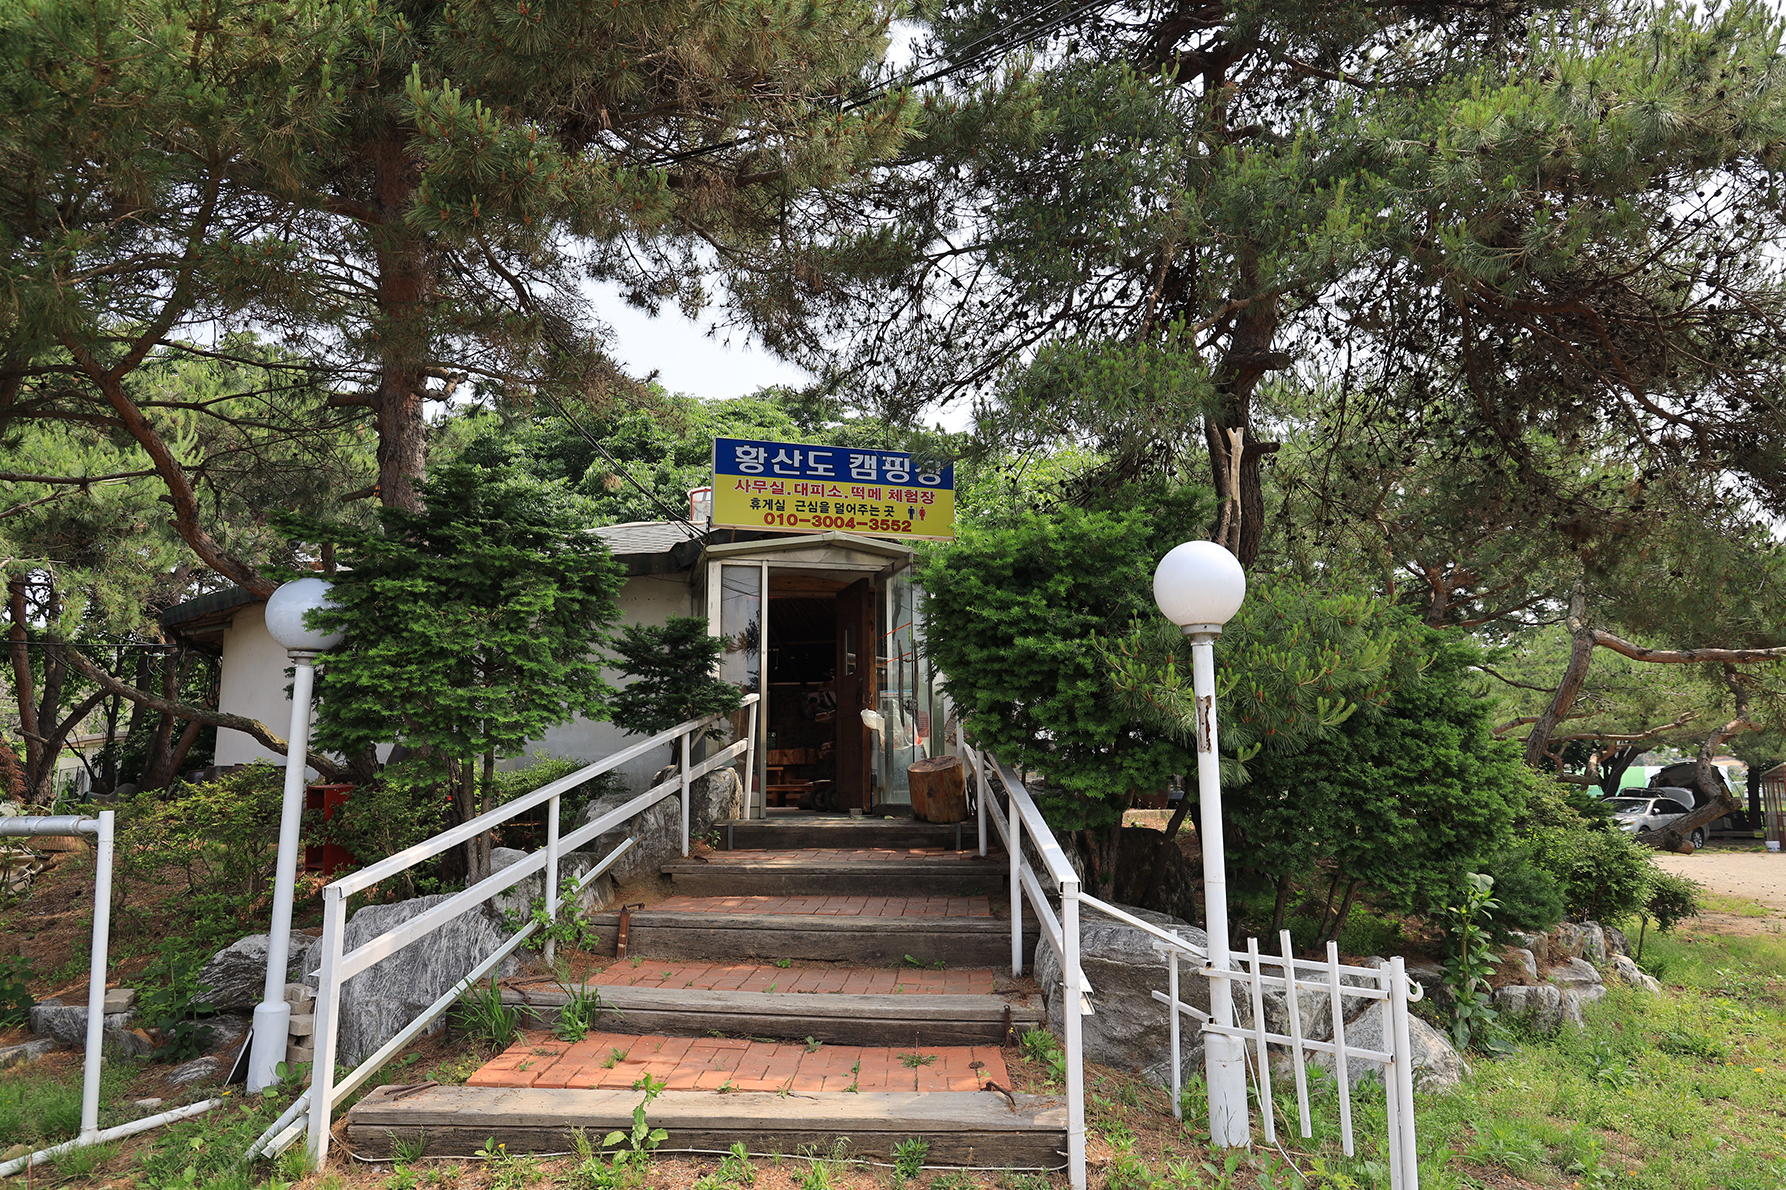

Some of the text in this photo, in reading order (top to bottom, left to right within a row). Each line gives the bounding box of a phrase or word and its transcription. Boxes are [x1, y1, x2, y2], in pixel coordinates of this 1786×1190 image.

[734, 444, 836, 477] 황산도
[887, 488, 936, 505] 체험장
[749, 497, 895, 518] 휴게실 근심을 덜어주는 곳
[764, 512, 912, 532] 010-3004-3552
